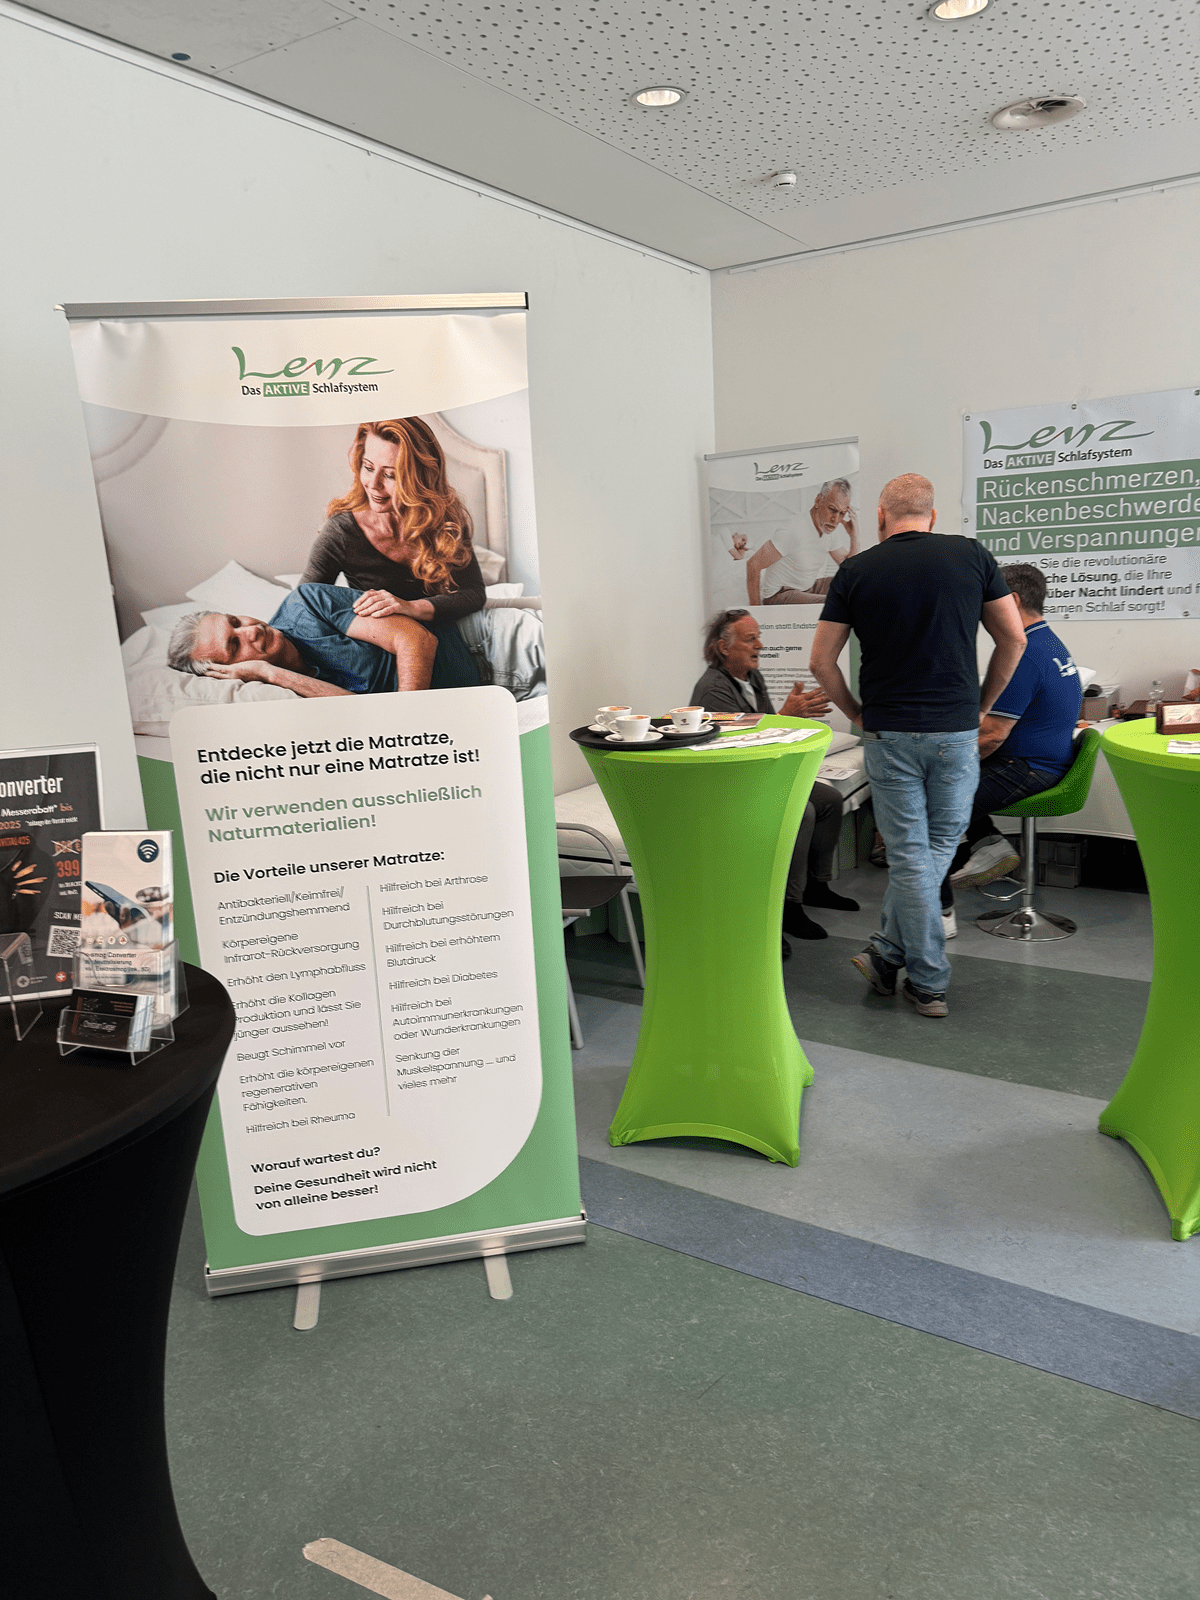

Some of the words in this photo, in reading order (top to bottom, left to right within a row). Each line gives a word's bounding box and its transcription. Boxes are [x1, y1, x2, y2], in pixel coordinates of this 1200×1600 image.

[231, 346, 394, 381] Lenz
[241, 385, 261, 396] Das
[264, 383, 308, 396] AKTIVE
[312, 382, 379, 395] Schlafsystem
[979, 420, 1155, 455] Lenz
[753, 462, 810, 475] Lenz
[984, 459, 1004, 469] Das
[1007, 454, 1053, 467] AKTIVE
[1057, 448, 1133, 463] Schlafsystem
[983, 468, 1200, 499] Rückenschmerzen,
[982, 532, 1021, 552] und
[1040, 558, 1060, 569] Sie
[1061, 556, 1081, 568] die
[1083, 554, 1168, 567] revolutionäre
[1070, 572, 1122, 585] Lösung,
[1124, 570, 1143, 581] die
[1147, 569, 1173, 580] Ihre
[1046, 588, 1076, 599] über
[1079, 587, 1117, 598] Nacht
[1120, 585, 1164, 596] lindert
[1167, 584, 1193, 595] und
[1085, 601, 1125, 613] Schlaf
[1127, 600, 1166, 614] sorgt!
[197, 743, 287, 763] Entdecke
[290, 740, 332, 760] jetzt
[336, 736, 364, 753] die
[368, 731, 454, 750] Matratze,
[200, 767, 231, 785] die
[235, 764, 285, 782] nicht
[289, 762, 320, 777] nur
[324, 758, 364, 774] eine
[369, 752, 449, 771] Matratze
[453, 749, 480, 764] ist!
[0, 774, 63, 798] onverter
[204, 806, 238, 822] Wir
[243, 796, 348, 818] verwenden
[352, 785, 482, 809] ausschließlich
[0, 820, 21, 830] 2025
[208, 815, 377, 843] Naturmaterialien!
[56, 859, 80, 878] 399
[214, 871, 240, 884] Die
[243, 863, 306, 880] Vorteile
[310, 858, 369, 873] unserer
[373, 850, 445, 868] Matratze:
[380, 881, 423, 893] Hilfreich
[424, 878, 442, 888] bei
[444, 874, 489, 886] Arthrose
[217, 886, 345, 910] Antibakteriell/Keimfrei/
[381, 904, 425, 916] Hilfreich
[427, 901, 444, 911] bei
[219, 903, 350, 926] Entzündungshemmend
[383, 910, 515, 931] Durchblutungsstörungen
[222, 933, 299, 950] Körpereigene
[385, 941, 428, 953] Hilfreich
[430, 938, 447, 948] bei
[449, 934, 501, 946] erhöhtem
[224, 941, 360, 964] Infrarot-Rückversorgung
[387, 954, 437, 968] Blutdruck
[227, 975, 264, 987] Erhöht
[266, 972, 288, 982] den
[290, 963, 366, 981] Lymphabfluss
[389, 978, 431, 990] Hilfreich
[433, 975, 450, 985] bei
[452, 971, 498, 983] Diabetes
[268, 995, 286, 1005] die
[289, 989, 337, 1003] Kollagen
[391, 1000, 433, 1012] Hilfreich
[435, 997, 453, 1007] bei
[293, 1006, 316, 1017] und
[317, 1003, 343, 1013] lässt
[345, 1001, 362, 1010] Sie
[392, 1004, 524, 1027] Autoimmunerkrankungen
[233, 1027, 270, 1041] jünger
[272, 1019, 329, 1034] aussehen!
[393, 1030, 418, 1041] oder
[420, 1018, 521, 1037] Wunderkrankungen
[237, 1050, 270, 1062] Beugt
[271, 1042, 327, 1056] Schimmel
[328, 1040, 346, 1049] vor
[395, 1050, 441, 1063] Senkung
[442, 1047, 461, 1057] der
[239, 1072, 275, 1084] Erhöht
[277, 1069, 294, 1079] die
[296, 1059, 374, 1077] körpereigenen
[396, 1058, 484, 1077] Muskelspannung
[495, 1053, 517, 1063] und
[242, 1080, 318, 1099] regenerativen
[398, 1079, 428, 1090] vieles
[429, 1075, 458, 1086] mehr
[243, 1096, 308, 1112] Fähigkeiten.
[246, 1121, 289, 1134] Hilfreich
[291, 1117, 309, 1127] bei
[311, 1112, 356, 1125] Rheuma
[251, 1157, 301, 1174] Worauf
[303, 1150, 355, 1166] wartest
[356, 1146, 381, 1159] du?
[254, 1182, 292, 1195] Deine
[294, 1170, 371, 1189] Gesundheit
[373, 1165, 401, 1178] wird
[404, 1160, 438, 1174] nicht
[256, 1199, 282, 1210] von
[284, 1192, 328, 1207] alleine
[331, 1184, 379, 1200] besser!
